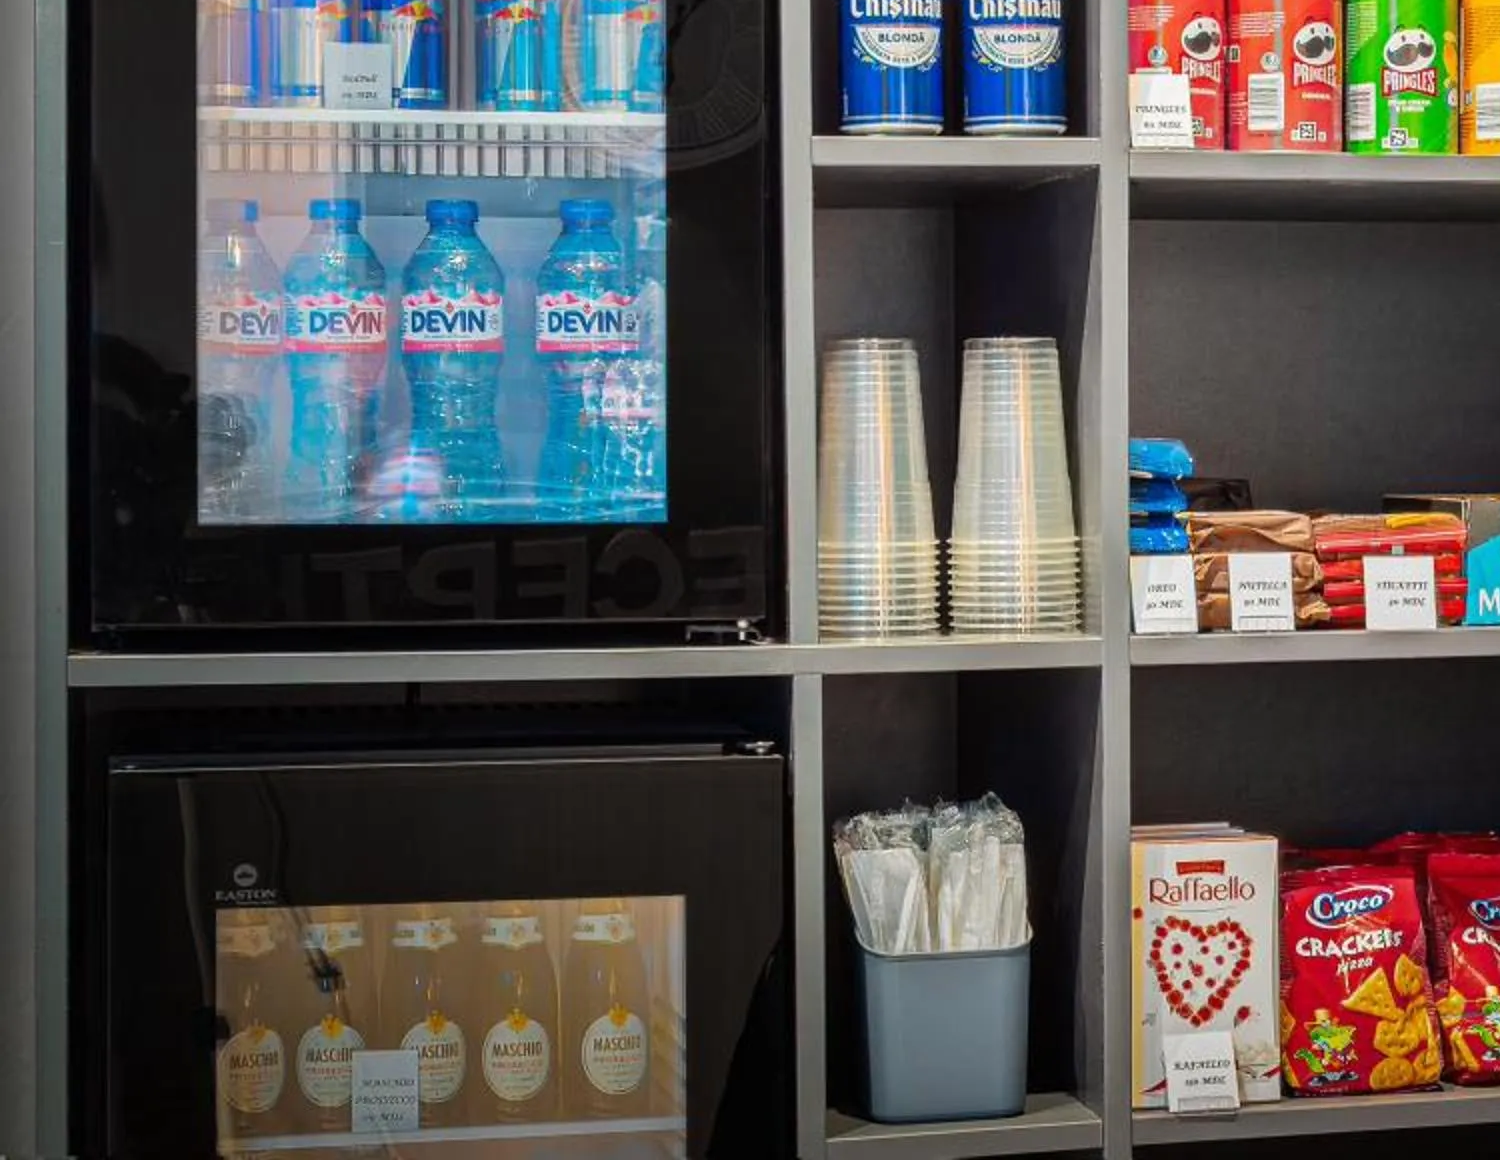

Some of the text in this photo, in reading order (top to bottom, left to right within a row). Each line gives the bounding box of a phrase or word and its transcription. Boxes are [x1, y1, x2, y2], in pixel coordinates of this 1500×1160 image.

[1383, 69, 1436, 95] PRINGLES
[219, 311, 279, 334] DEVI
[309, 309, 382, 334] DEVIN
[411, 309, 486, 334] DEVIN
[547, 309, 624, 334] DEVIN
[214, 890, 277, 903] EASTON
[1149, 875, 1256, 907] Raffaello
[1312, 893, 1384, 920] Croco
[1295, 928, 1403, 957] CRACKERS
[305, 1047, 353, 1063] MASCHI
[491, 1041, 543, 1058] MASCHIO
[593, 1035, 642, 1053] MASCHIO
